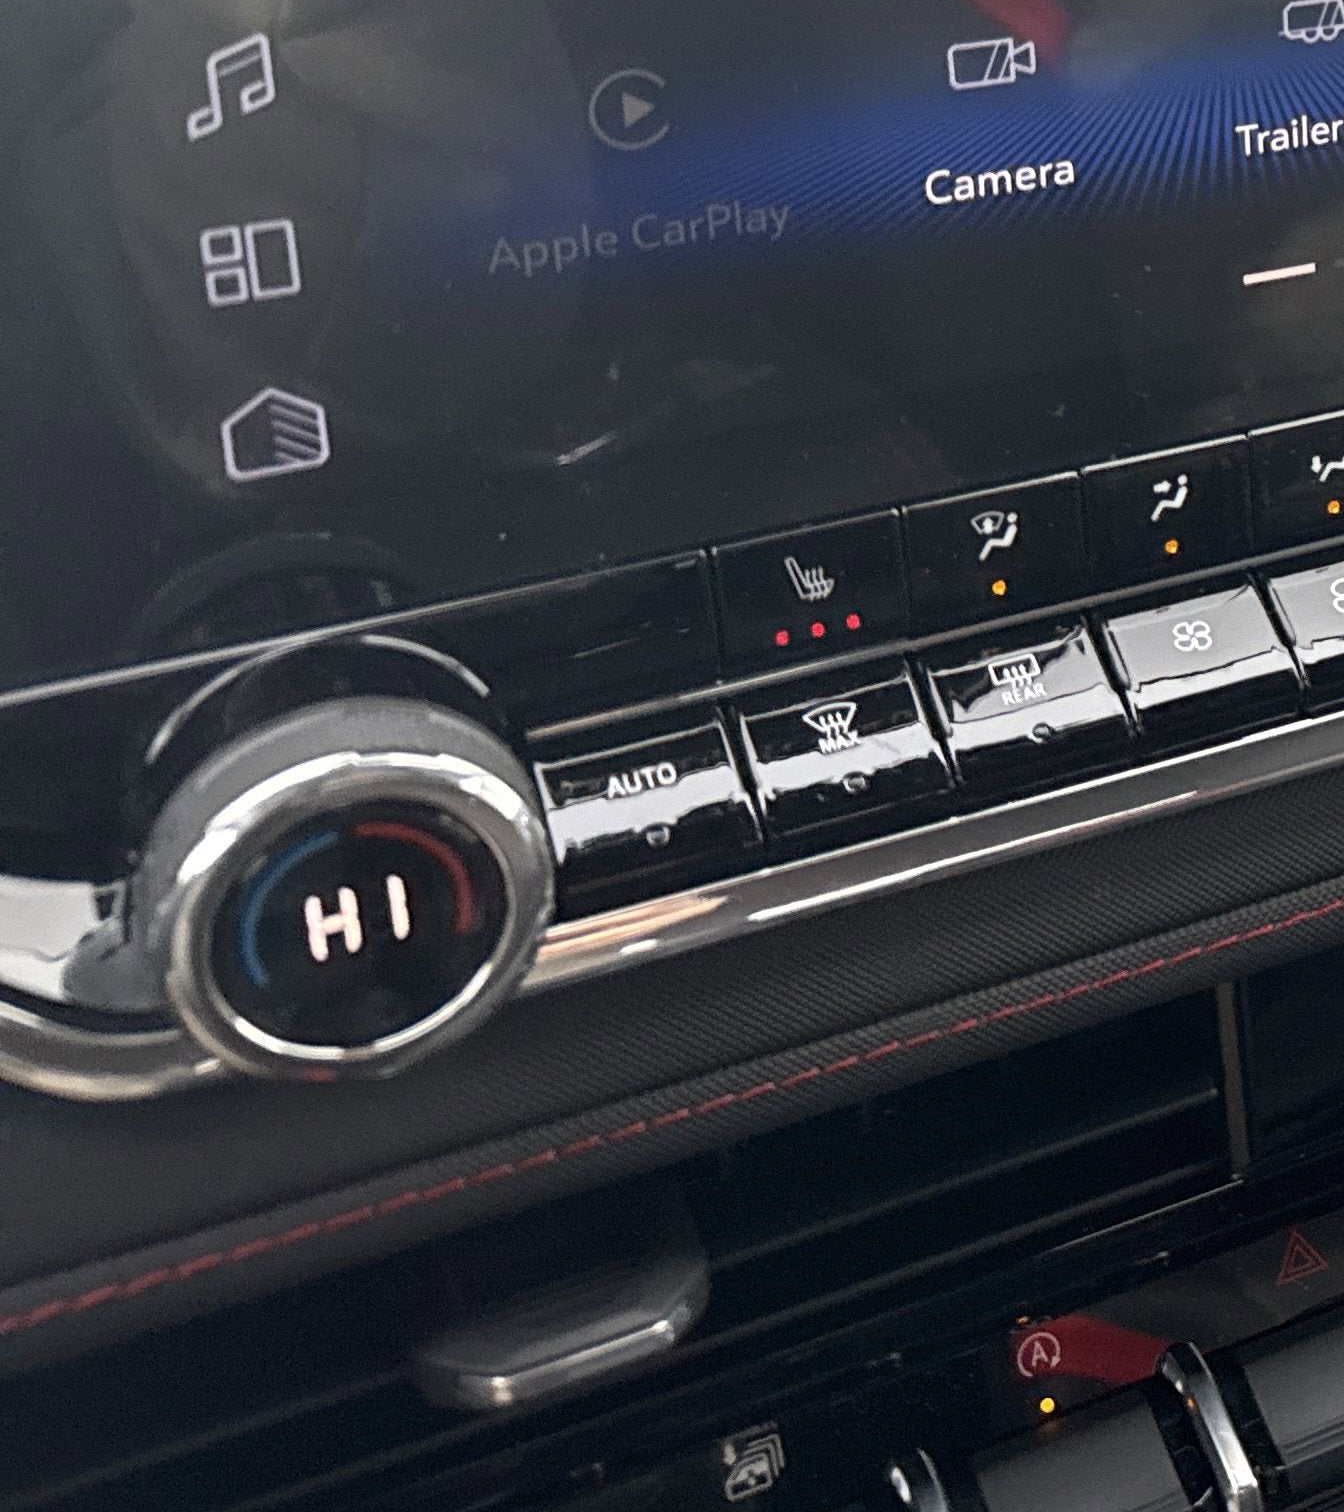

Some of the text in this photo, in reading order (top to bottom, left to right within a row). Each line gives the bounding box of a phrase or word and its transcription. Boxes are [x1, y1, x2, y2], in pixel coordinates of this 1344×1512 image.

[925, 159, 1076, 205] Camera
[487, 198, 791, 279] Apple CarPlay
[1001, 682, 1047, 706] REAR
[817, 729, 862, 754] MAX
[606, 761, 677, 799] AUTO
[303, 873, 411, 963] HI
